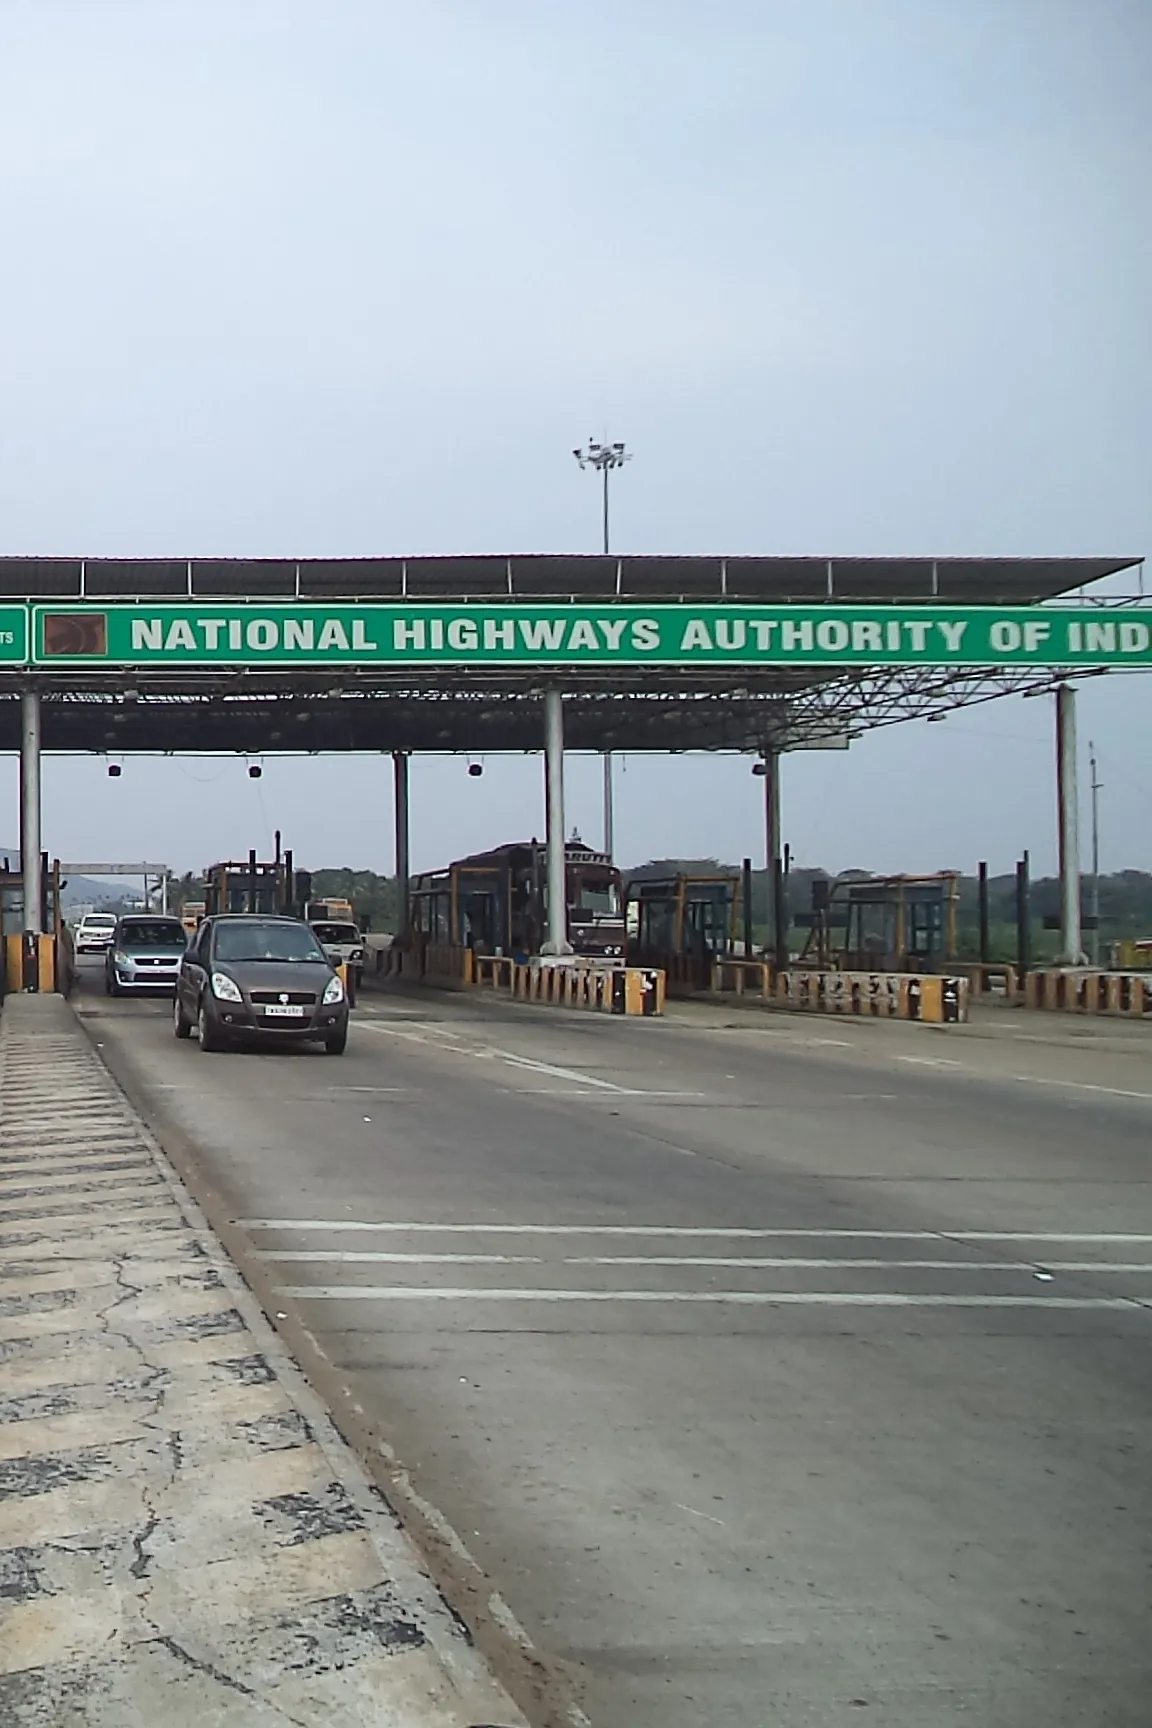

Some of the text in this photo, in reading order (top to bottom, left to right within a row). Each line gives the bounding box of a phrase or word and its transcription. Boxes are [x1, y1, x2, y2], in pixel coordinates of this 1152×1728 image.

[131, 619, 1149, 652] NATIONAL HIGHWAYS AUTHORITY OF IND
